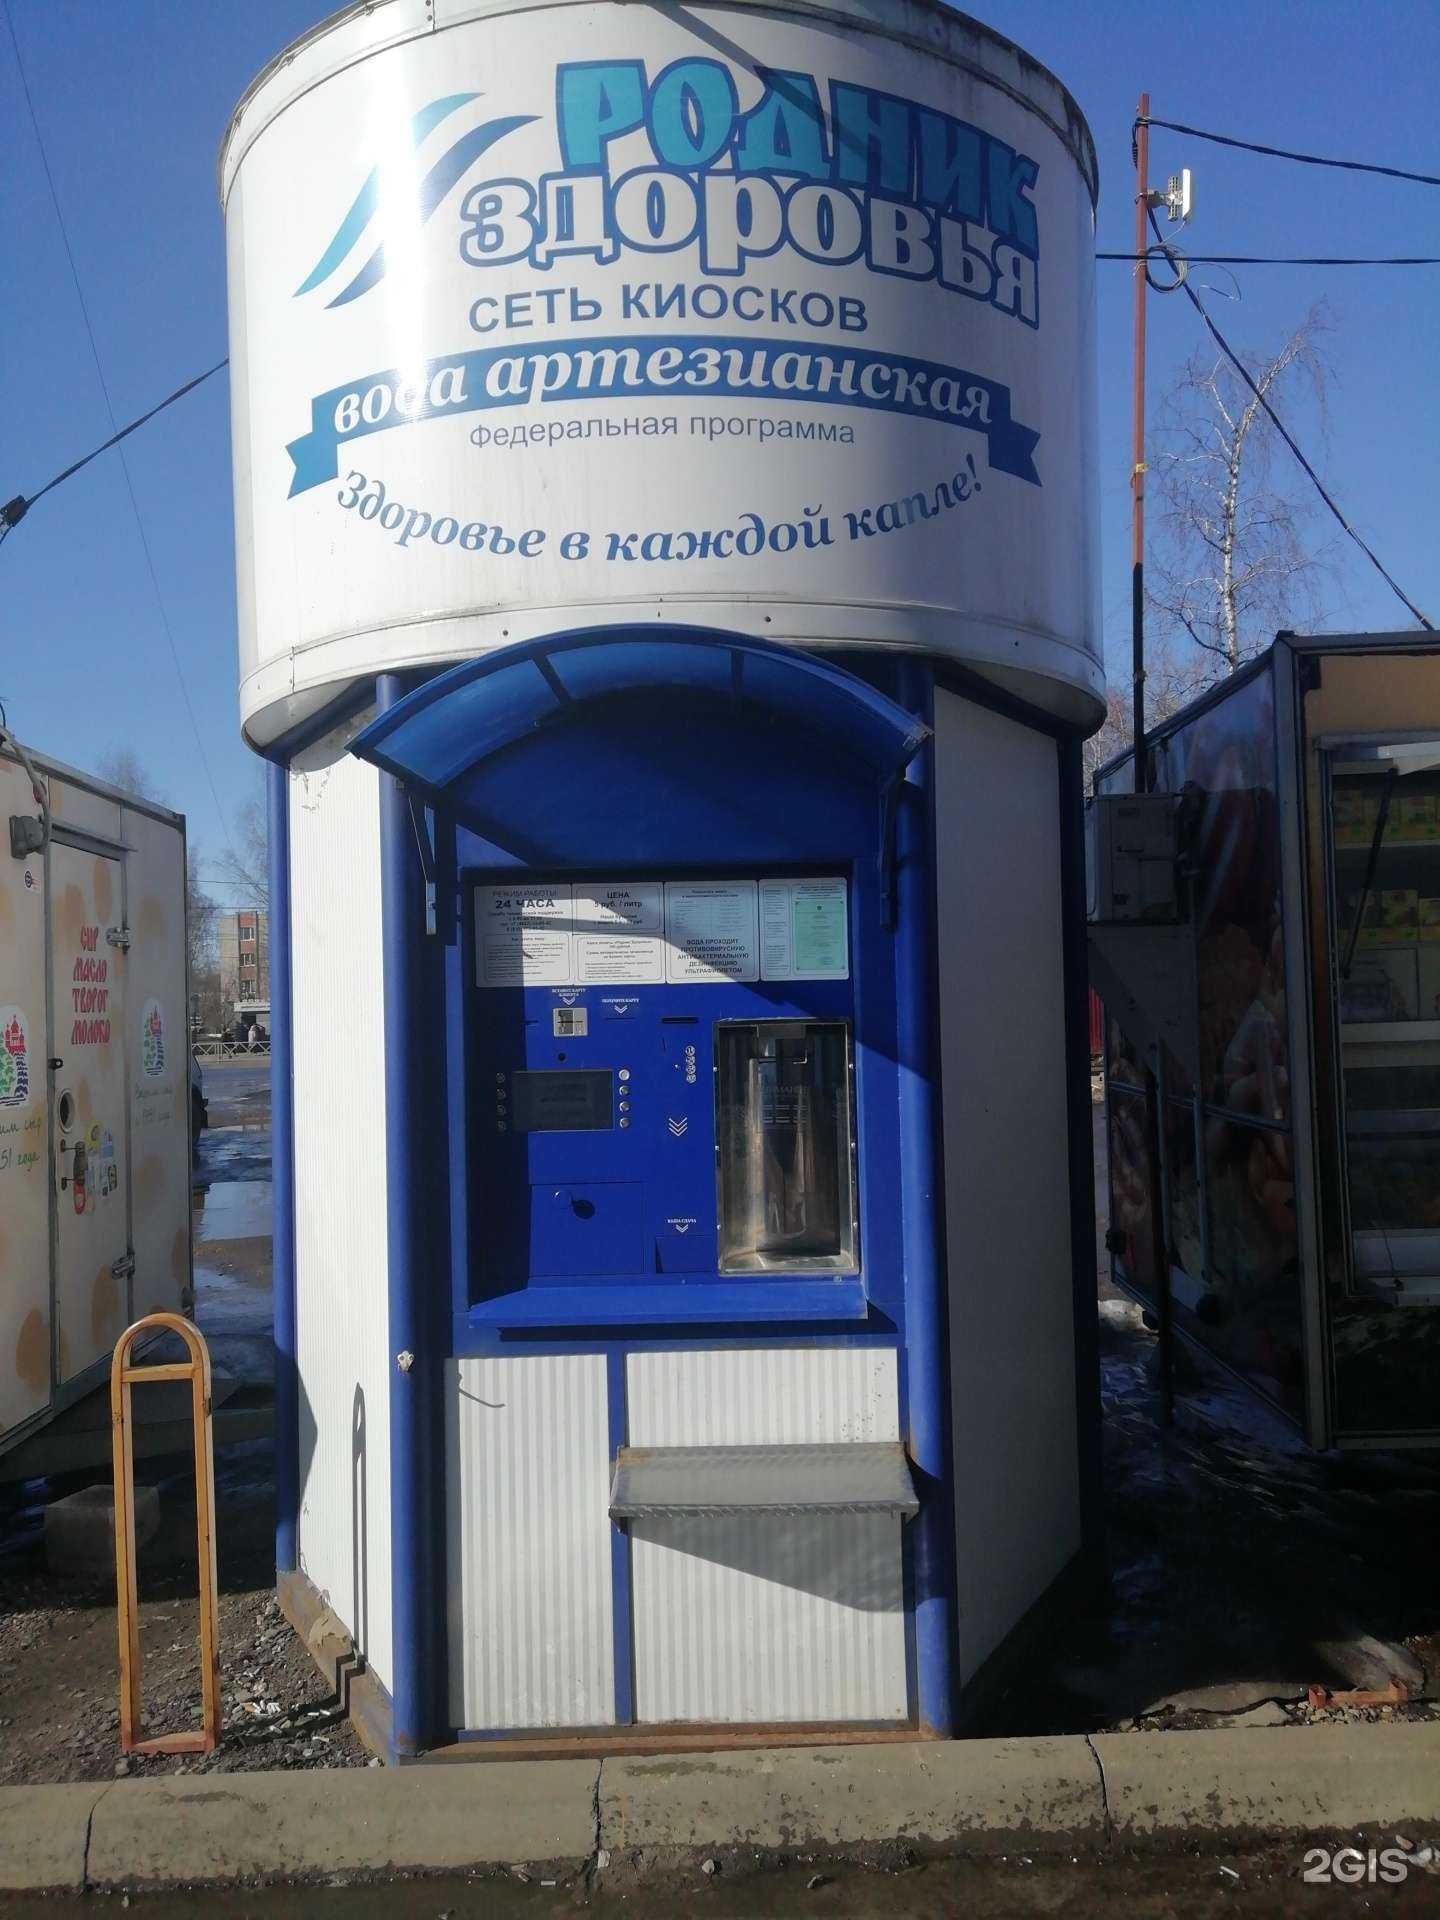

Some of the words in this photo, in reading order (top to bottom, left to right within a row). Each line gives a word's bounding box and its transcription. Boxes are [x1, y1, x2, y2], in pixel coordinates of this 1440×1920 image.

[555, 56, 1040, 260] РОДНИК
[469, 287, 602, 333] СЕТЬ
[621, 282, 869, 333] КИОСКОВ
[485, 347, 993, 424] артезианская
[690, 415, 855, 443] программа
[337, 469, 546, 559] Здоровье
[560, 529, 591, 561] в
[604, 503, 835, 561] каждой
[843, 452, 983, 541] капле!
[495, 900, 511, 909] 24
[516, 898, 555, 908] ЧАСА
